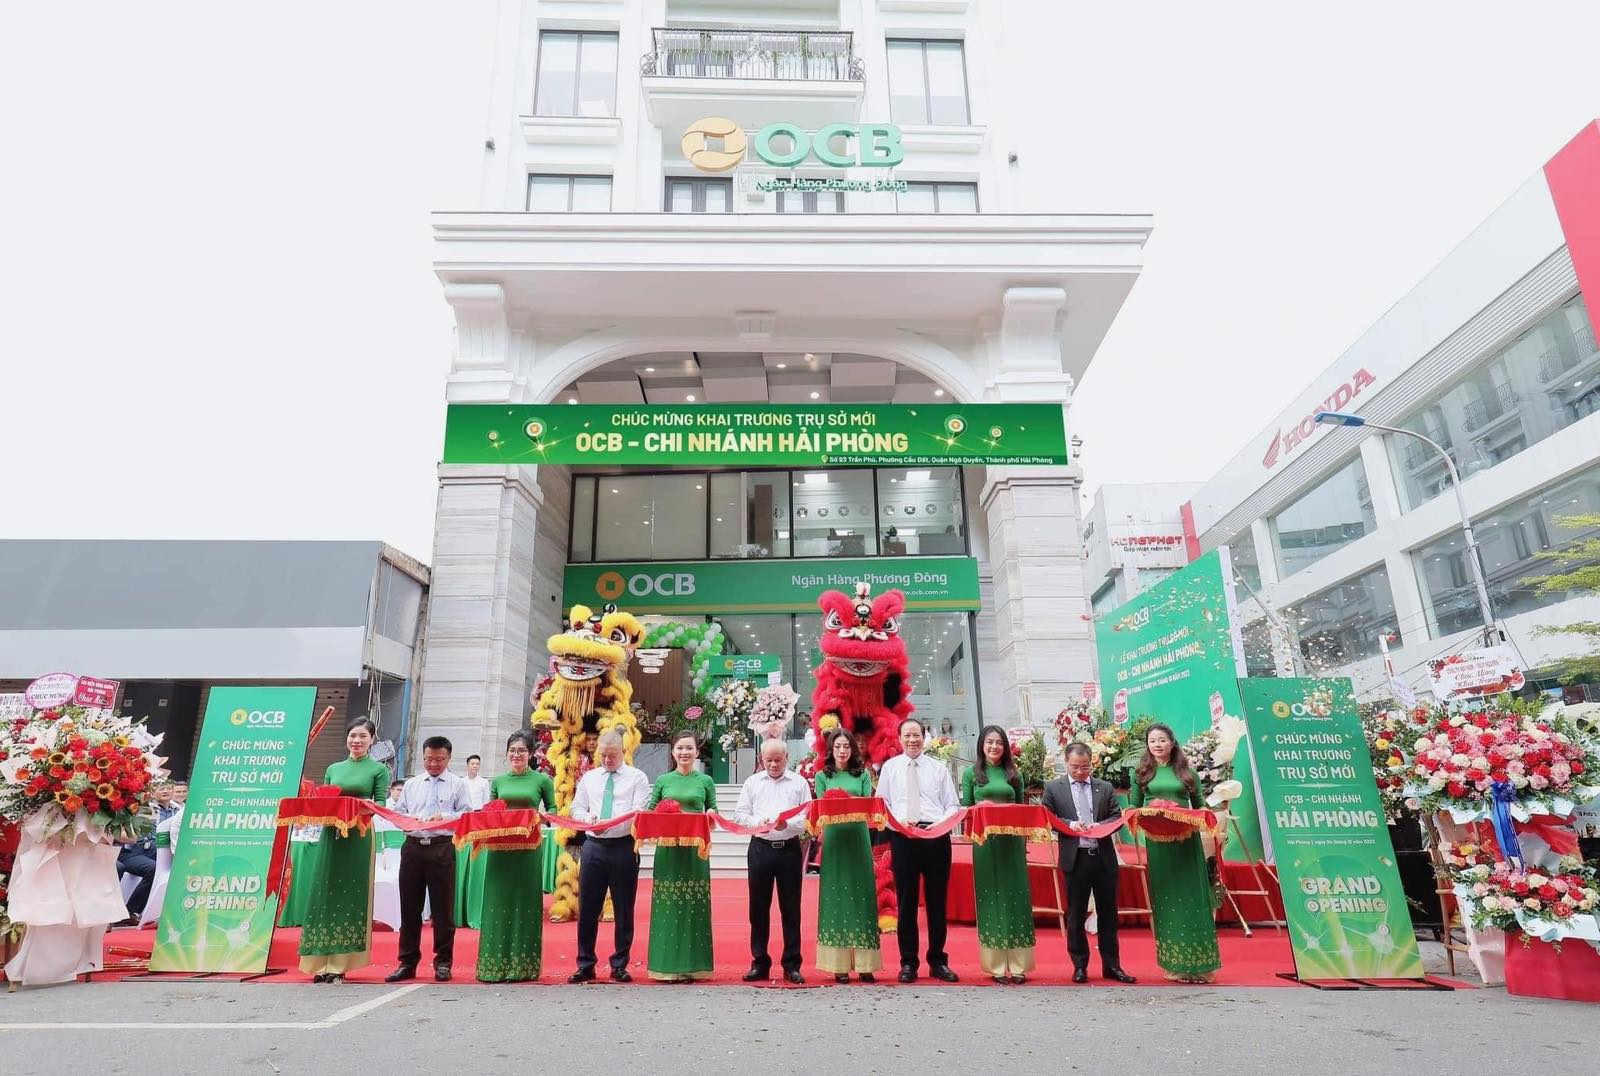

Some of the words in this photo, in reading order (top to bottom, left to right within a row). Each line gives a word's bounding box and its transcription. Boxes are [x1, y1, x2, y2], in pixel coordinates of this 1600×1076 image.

[755, 122, 903, 167] OCB
[612, 411, 650, 426] CHÚC
[653, 411, 694, 426] MỪNG
[697, 413, 731, 426] KHAI
[734, 413, 792, 426] TRƯƠNG
[796, 413, 825, 429] TRỤ
[828, 410, 847, 426] SỞ
[851, 411, 876, 426] MỚI
[575, 432, 623, 452] OCB
[644, 432, 682, 452] CHI
[688, 428, 773, 452] NHÁNH
[778, 427, 820, 452] HẢI
[826, 428, 908, 452] PHÒNG
[628, 573, 696, 597] OCB
[792, 574, 824, 588] Ngân
[828, 574, 860, 587] Hàng
[864, 573, 910, 586] Phương
[914, 572, 947, 585] Đông
[1133, 607, 1149, 625] OCB
[248, 710, 286, 724] OCB
[222, 737, 250, 750] CHÚC
[1276, 731, 1307, 744] CHÚC
[1310, 731, 1342, 744] MỪNG
[213, 755, 241, 766] KHAI
[243, 754, 287, 766] TRƯƠNG
[1274, 750, 1302, 760] KHAI
[1304, 749, 1351, 760] TRƯƠNG
[211, 771, 237, 786] TRỤ
[240, 768, 257, 783] SỞ
[259, 769, 283, 783] MỚI
[1277, 766, 1306, 782] TRỤ
[1310, 763, 1328, 778] SỞ
[1331, 763, 1356, 779] MỚI
[206, 798, 224, 806] OCB
[231, 798, 244, 806] CHI
[1284, 795, 1304, 804] OCB
[1312, 794, 1327, 804] CHI
[1328, 793, 1361, 804] NHÁNH
[189, 808, 222, 829] HẢI
[1275, 805, 1310, 828] HẢI
[1312, 806, 1378, 828] PHÒNG
[186, 875, 261, 893] GRAND
[1301, 875, 1381, 895] GRAND
[183, 895, 258, 910] OPENING
[1307, 897, 1386, 912] OPENING
